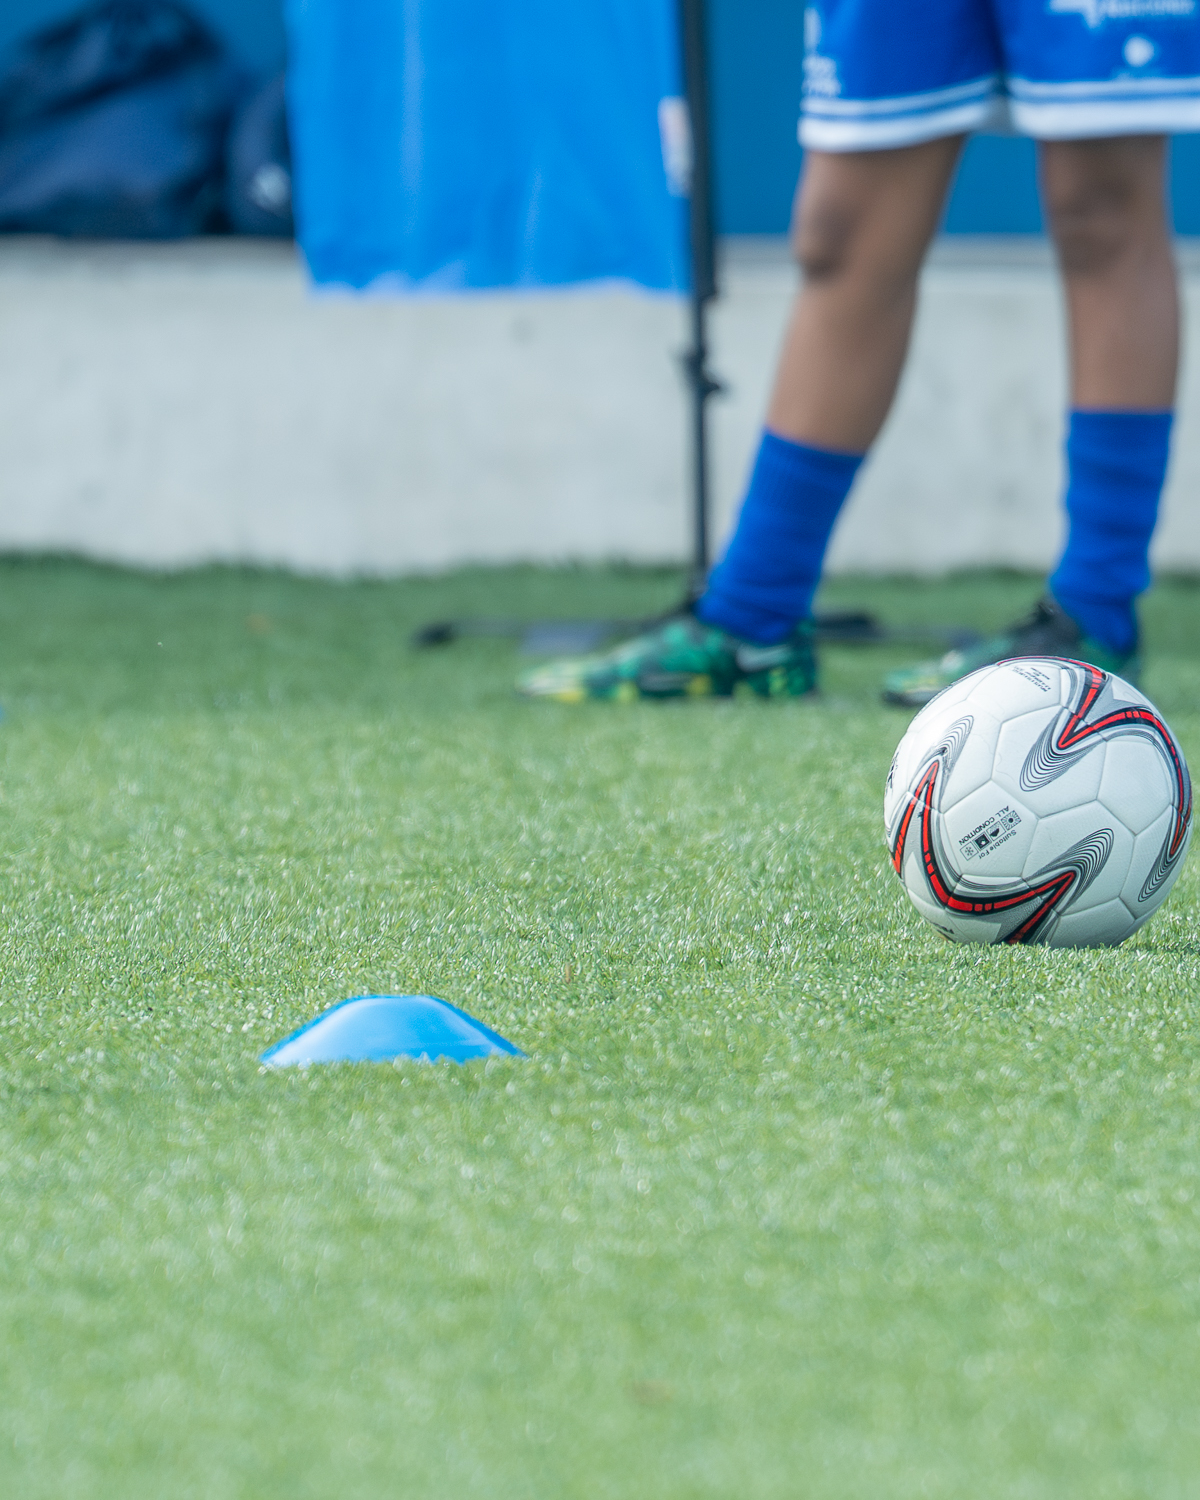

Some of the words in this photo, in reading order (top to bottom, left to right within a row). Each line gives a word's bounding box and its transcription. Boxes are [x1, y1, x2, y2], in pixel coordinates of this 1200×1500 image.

[995, 805, 1010, 818] ALL
[958, 816, 996, 846] CONDITION
[989, 829, 1017, 851] Suitable
[978, 849, 990, 860] For
